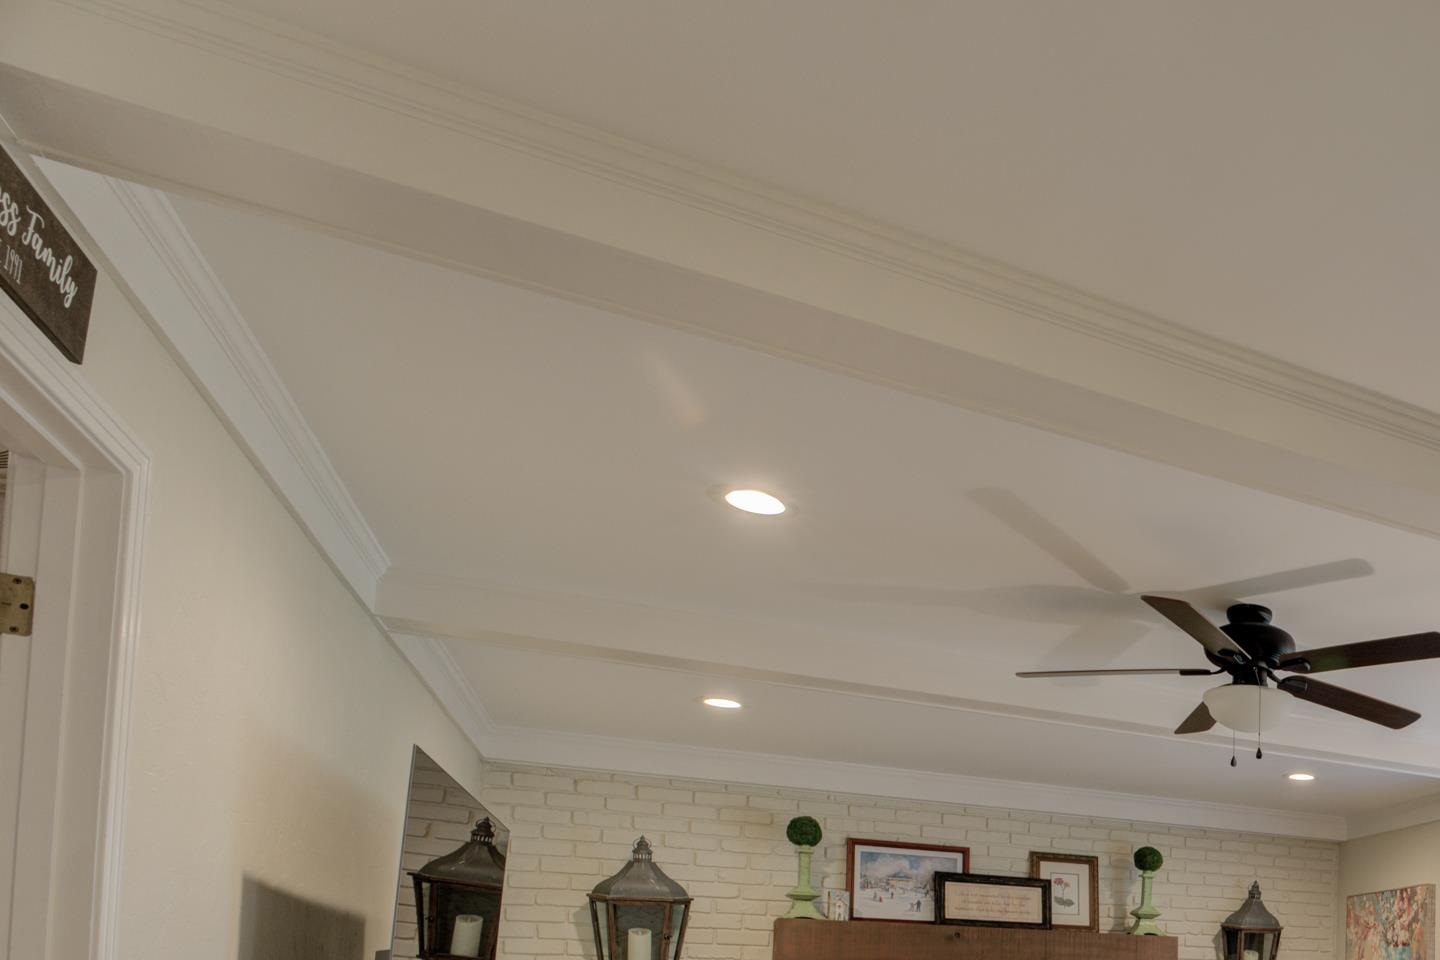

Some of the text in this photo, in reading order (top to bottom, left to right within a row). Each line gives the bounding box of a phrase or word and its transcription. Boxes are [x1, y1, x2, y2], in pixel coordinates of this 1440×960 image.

[0, 187, 78, 308] ss Family
[4, 245, 23, 285] 1991
